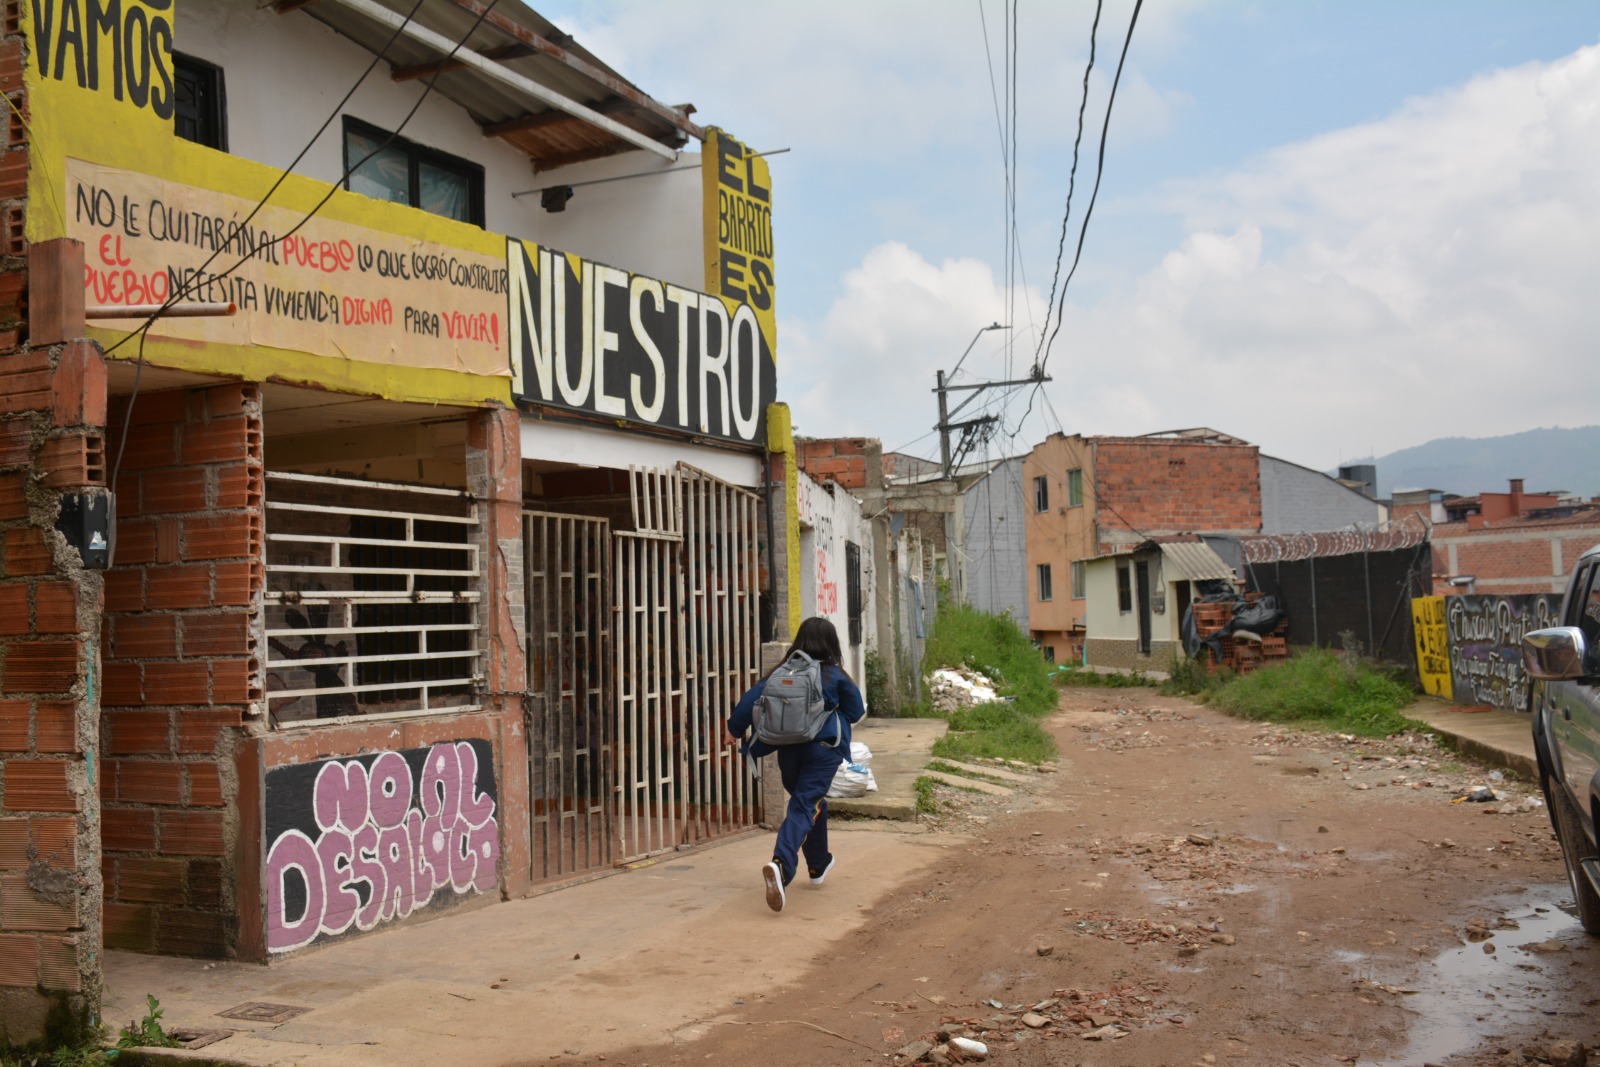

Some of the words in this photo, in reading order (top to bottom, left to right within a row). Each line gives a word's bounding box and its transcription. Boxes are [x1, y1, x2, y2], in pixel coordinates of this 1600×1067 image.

[31, 0, 174, 120] VAMOS
[717, 133, 769, 203] EL
[76, 183, 116, 228] NO
[122, 195, 141, 237] LE
[148, 199, 255, 259] QUITARÁN
[258, 230, 279, 266] AL
[282, 234, 355, 273] PUEBLO
[357, 243, 373, 272] LO
[377, 249, 411, 280] QUE
[412, 251, 448, 281] LOGRÓ
[448, 257, 508, 295] CONSTRUIR
[99, 233, 131, 266] EL
[718, 188, 773, 260] BARRIO
[168, 264, 258, 311] NECESITA
[264, 283, 339, 324] VIVIENDA
[342, 296, 393, 326] DIGNA
[404, 306, 439, 339] PARA
[442, 309, 500, 351] VIVIR!
[719, 248, 774, 311] ES
[507, 239, 761, 441] NUESTRO
[313, 751, 413, 835] NO
[420, 741, 495, 831] AL
